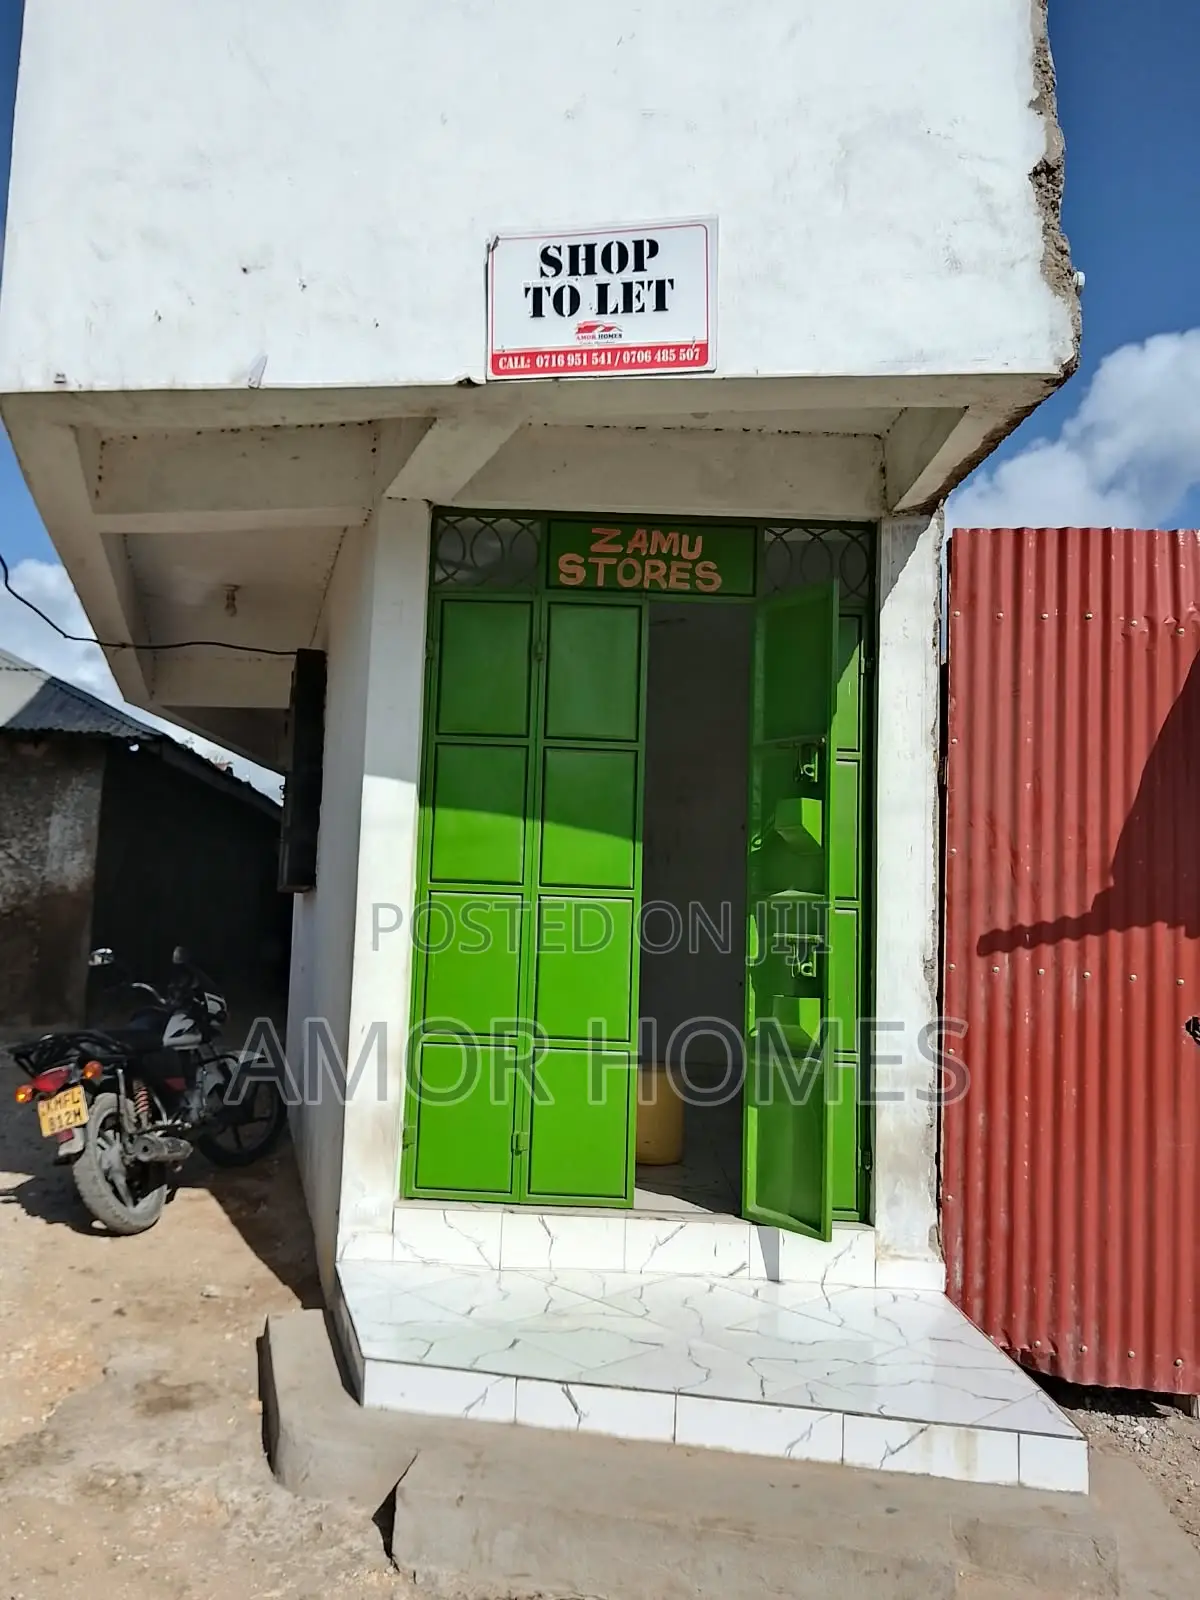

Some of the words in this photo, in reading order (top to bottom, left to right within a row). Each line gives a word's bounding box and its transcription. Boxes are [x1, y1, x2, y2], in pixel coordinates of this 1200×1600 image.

[539, 238, 659, 278] SHOP
[524, 284, 581, 318] TO
[595, 278, 675, 315] LET
[498, 356, 531, 370] CALL:
[535, 354, 565, 368] 0716
[566, 352, 588, 366] 951
[591, 351, 613, 366] 541
[614, 351, 621, 367] /
[622, 350, 652, 364] 0706
[654, 348, 676, 363] 485
[679, 347, 700, 361] 507
[590, 527, 703, 560] ZAMU
[558, 553, 722, 592] STORES
